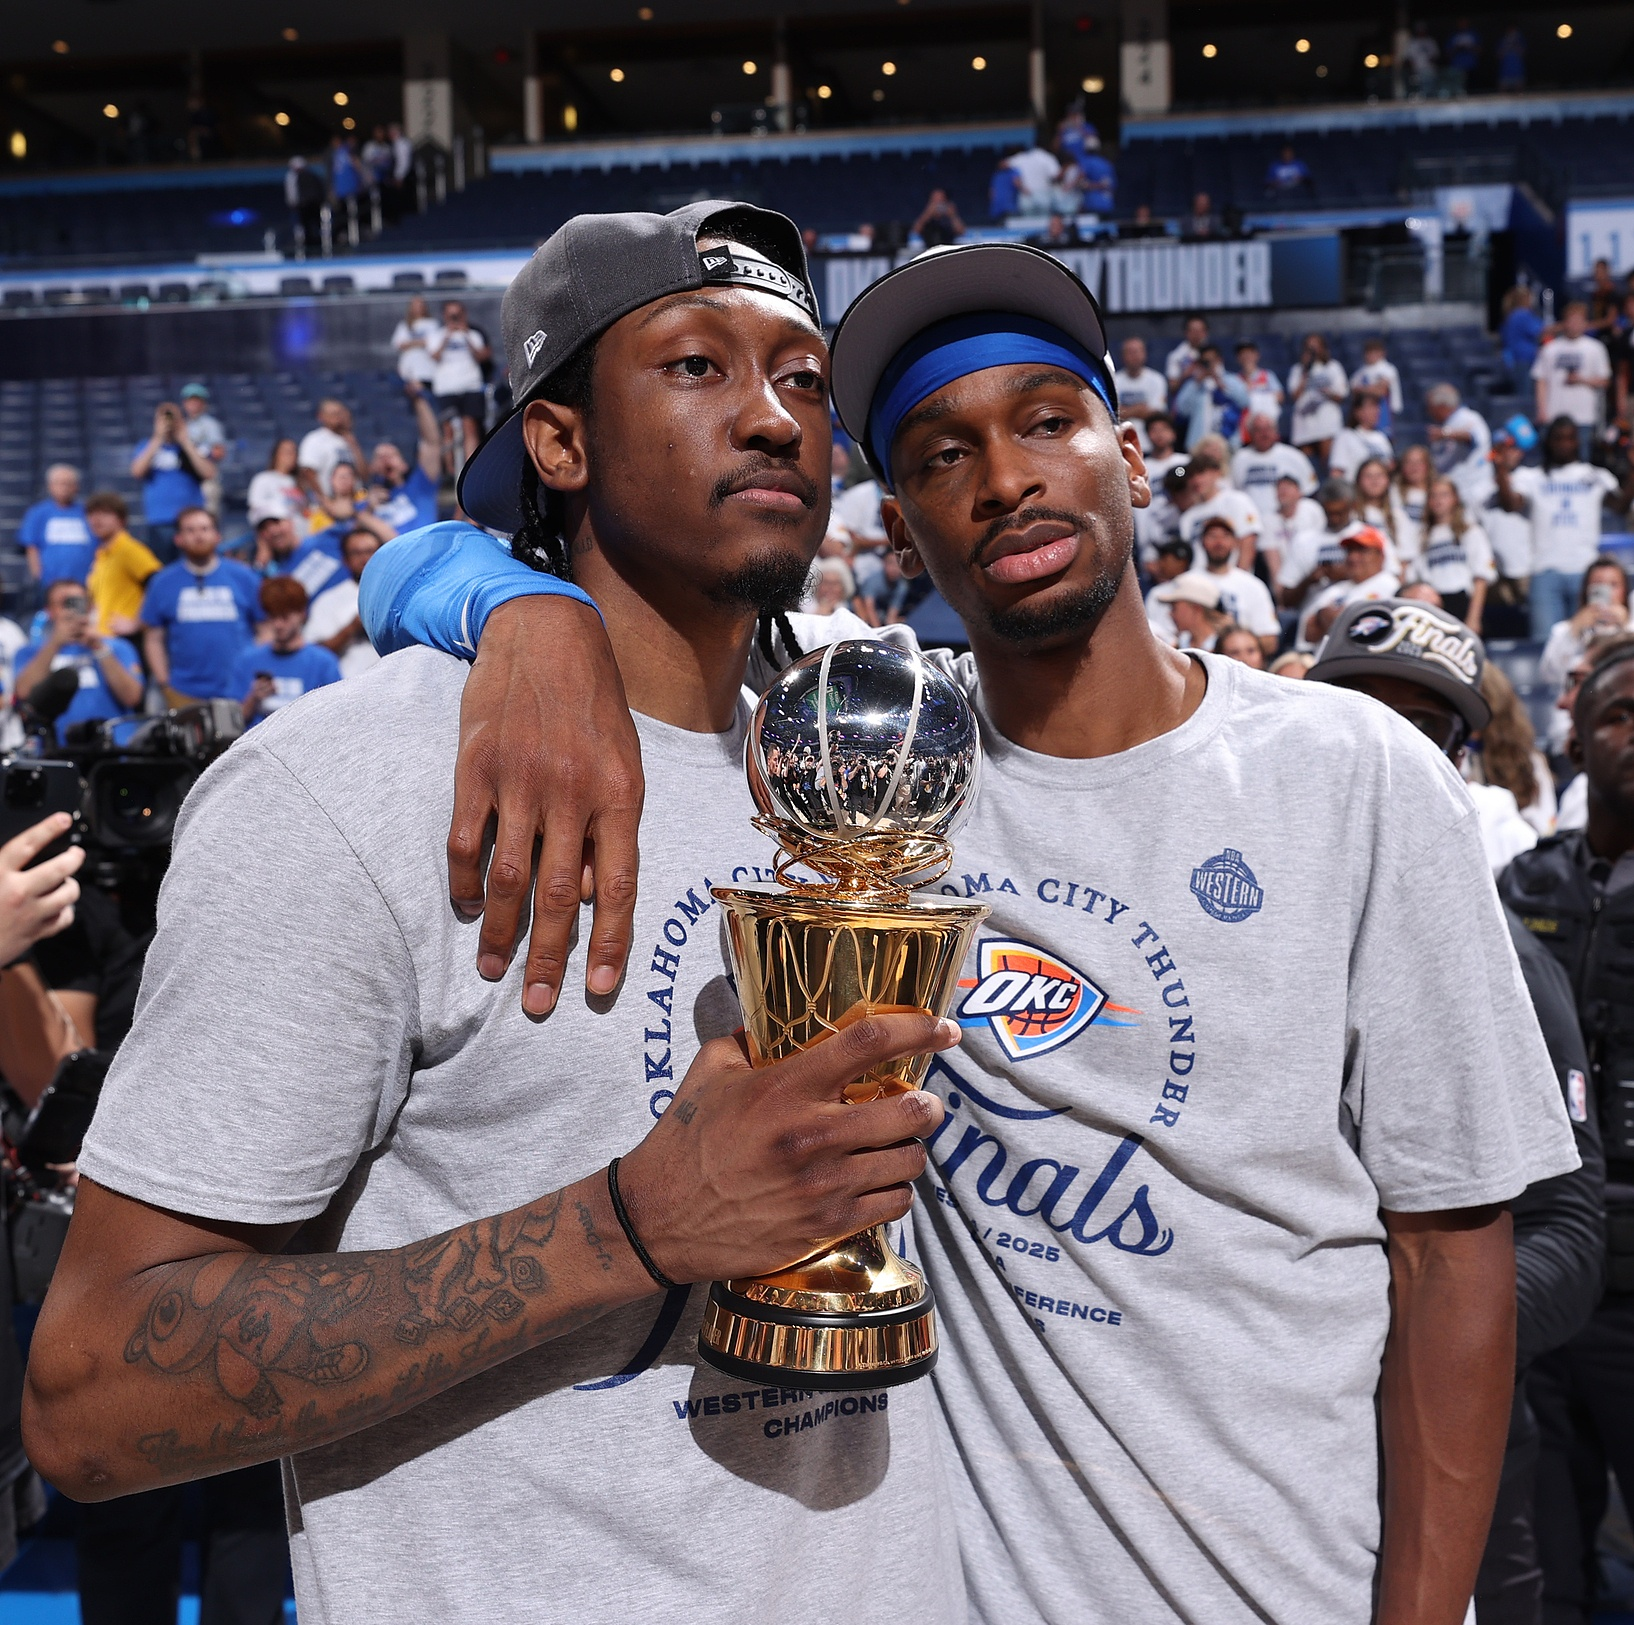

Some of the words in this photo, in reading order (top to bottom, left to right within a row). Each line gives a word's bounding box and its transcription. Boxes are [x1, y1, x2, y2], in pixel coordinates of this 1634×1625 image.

[1106, 240, 1272, 313] THUNDER
[1367, 605, 1478, 685] Finals
[1195, 871, 1259, 907] WESTERN
[962, 970, 1078, 1015] OKC
[1037, 878, 1130, 925] CITY
[1131, 921, 1196, 1128] THUNDER
[996, 1232, 1060, 1263] 2025
[1013, 1285, 1123, 1326] FERENCE
[763, 1392, 889, 1439] CHAMPIONS
